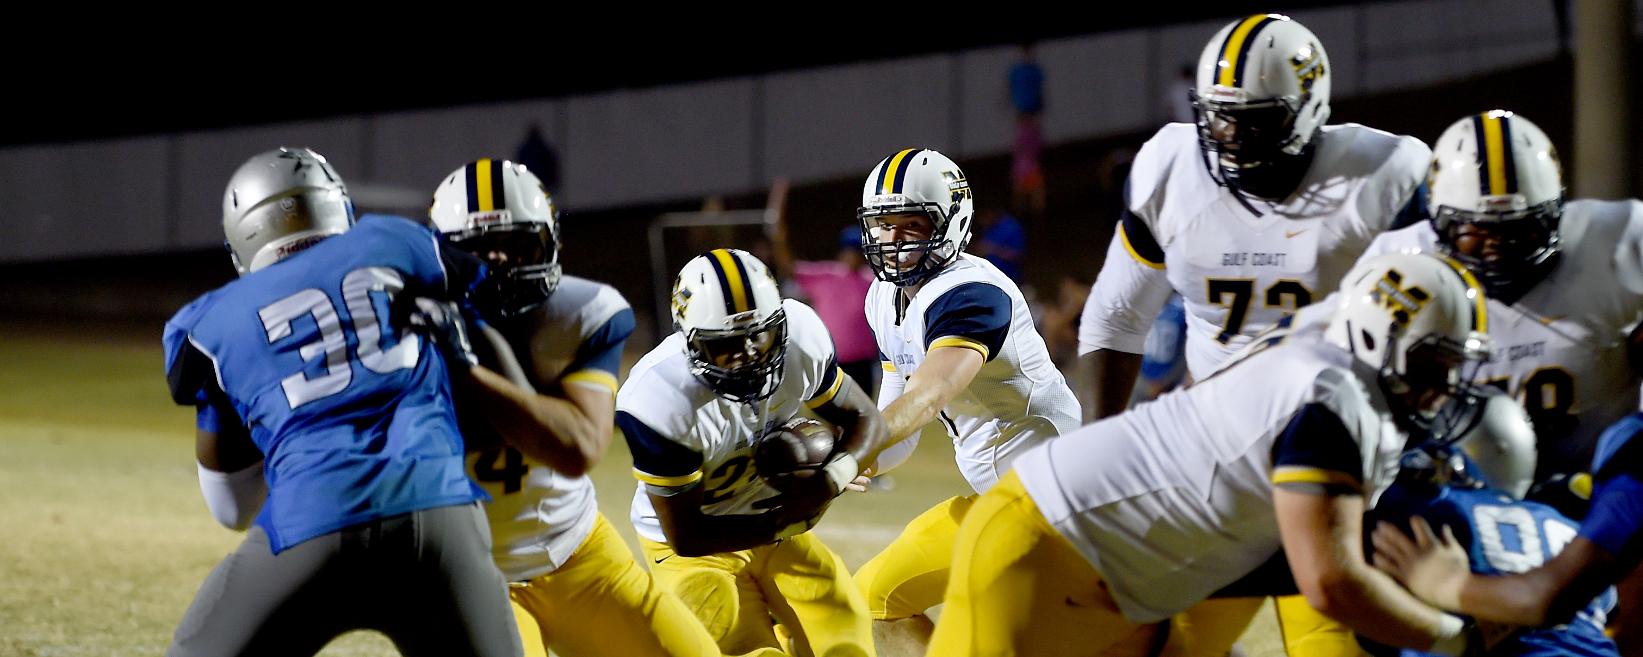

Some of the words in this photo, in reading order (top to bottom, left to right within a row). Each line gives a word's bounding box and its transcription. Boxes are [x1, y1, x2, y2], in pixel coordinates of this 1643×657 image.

[1221, 252, 1248, 267] GULF
[1251, 252, 1287, 267] COAST
[257, 265, 421, 411] 30
